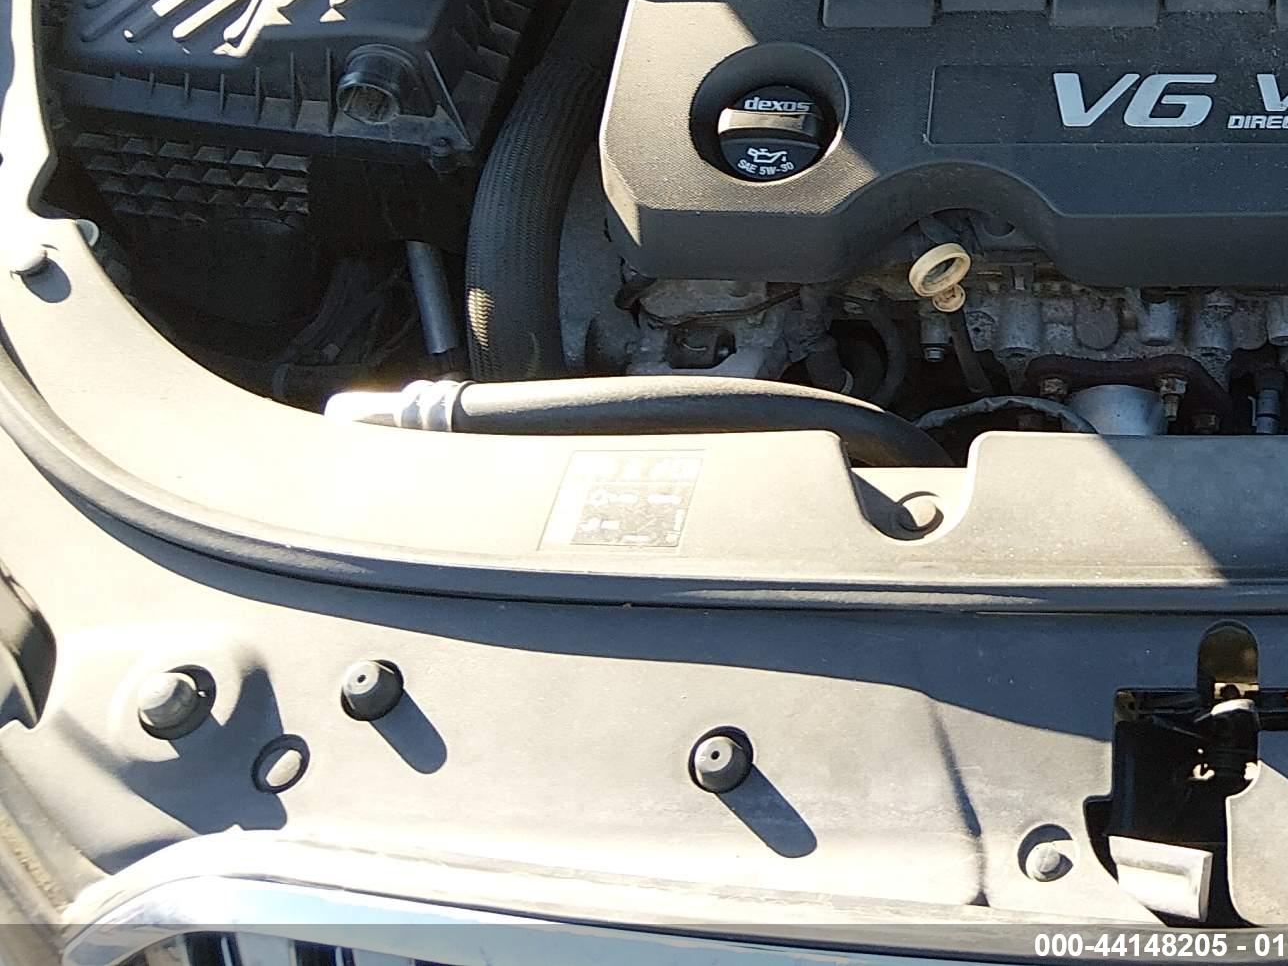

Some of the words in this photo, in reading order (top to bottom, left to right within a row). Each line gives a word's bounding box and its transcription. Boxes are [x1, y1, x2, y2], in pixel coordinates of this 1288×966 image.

[744, 96, 812, 112] dexos
[1053, 73, 1217, 128] V6
[737, 159, 758, 174] SAE
[760, 162, 794, 175] 5W-30
